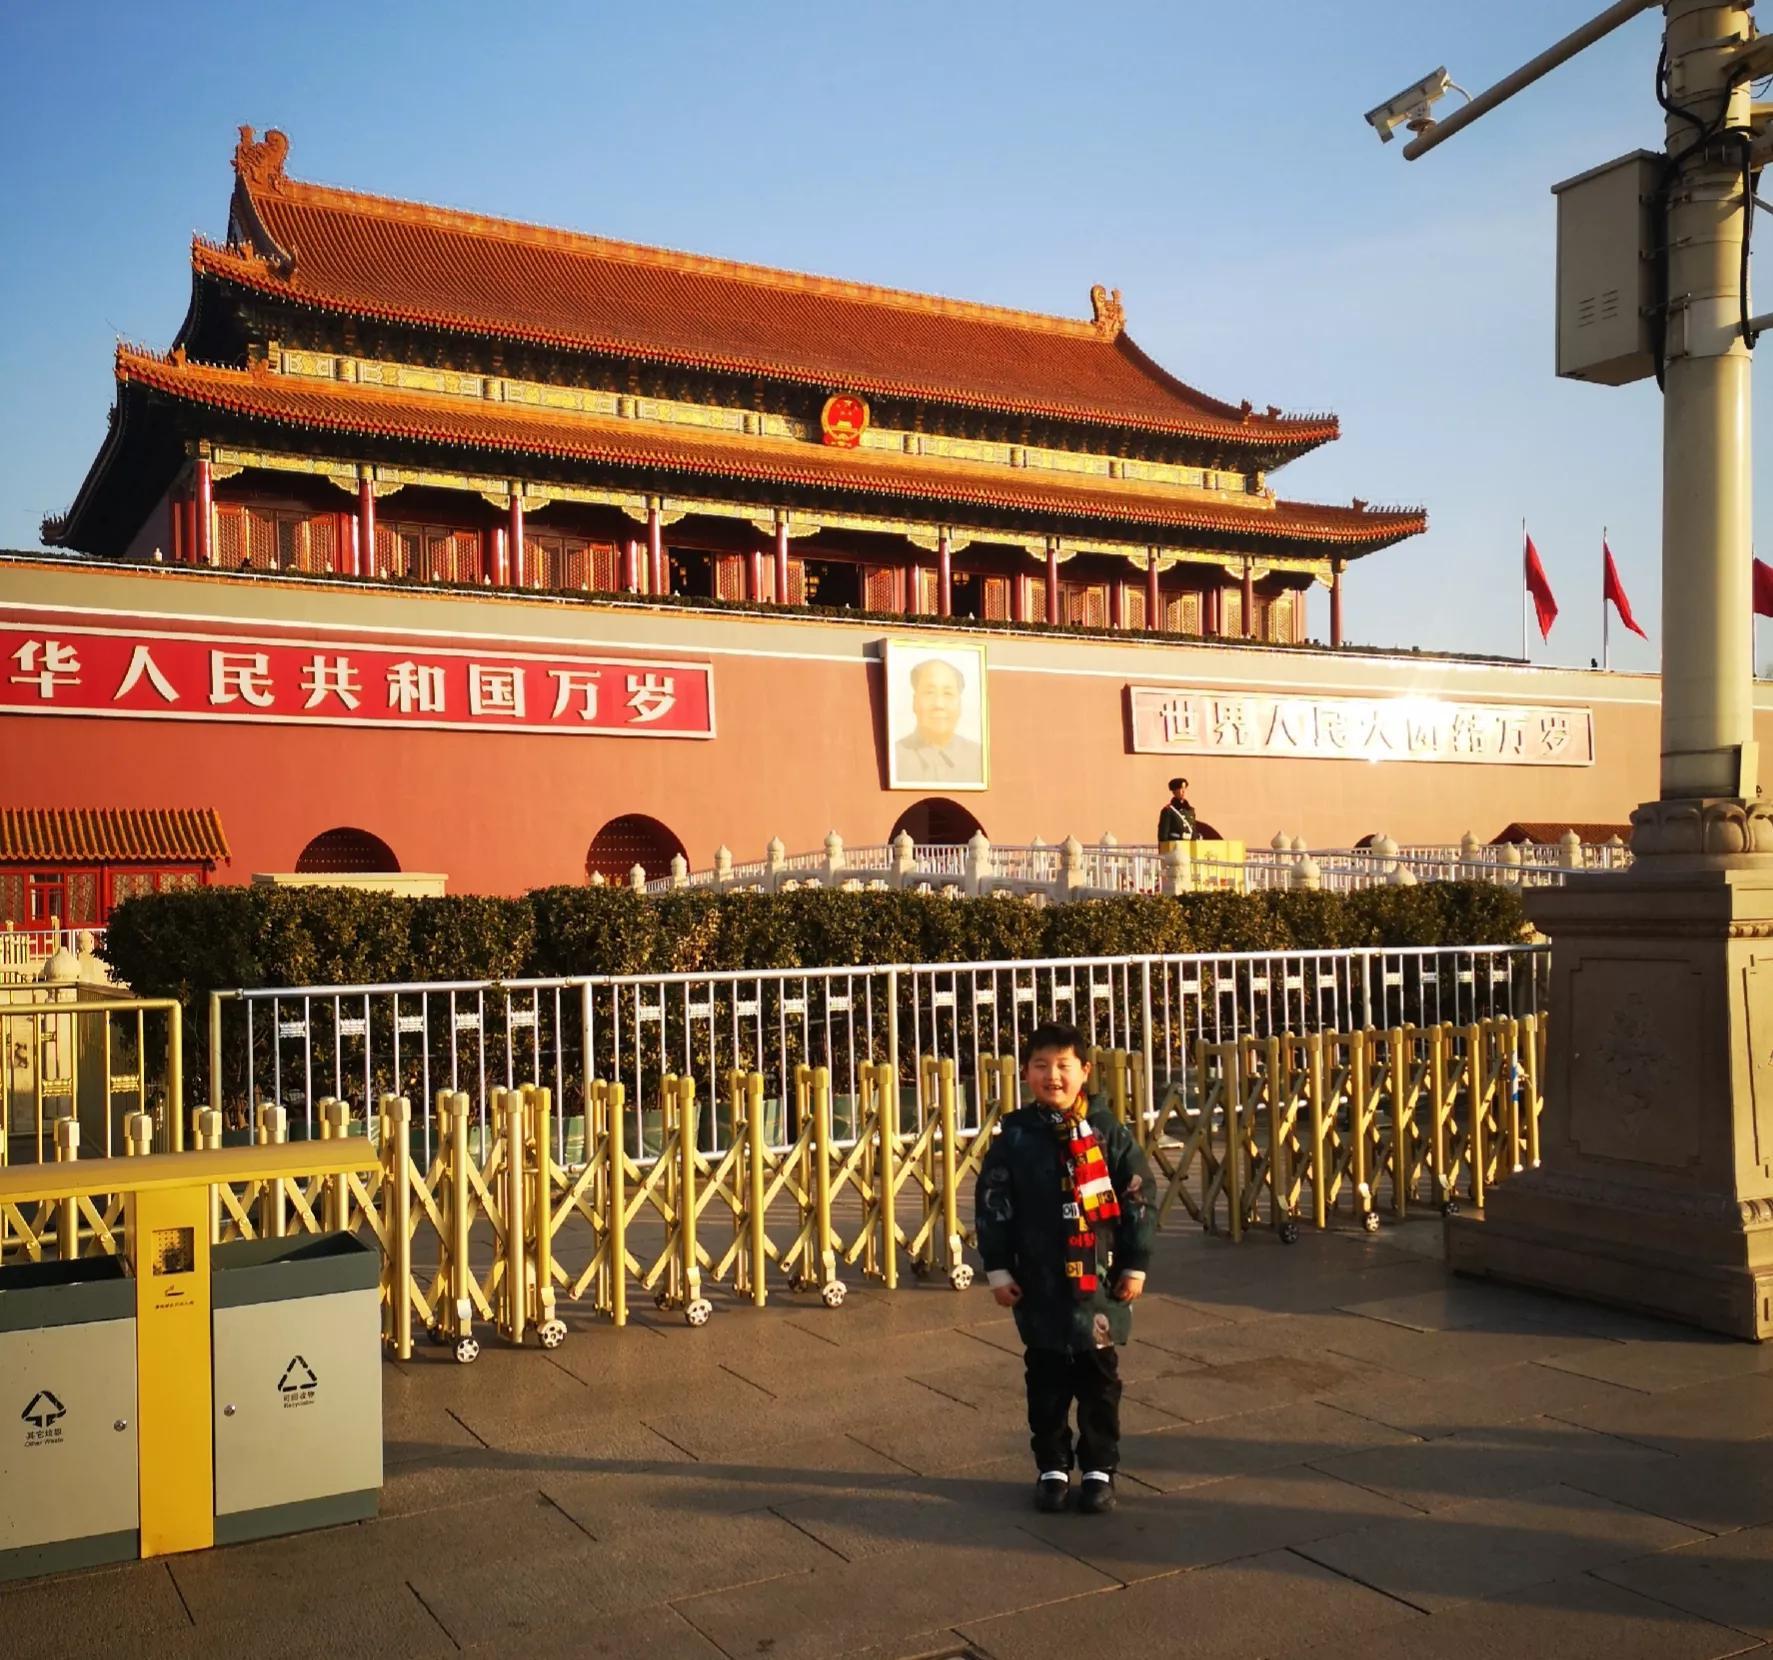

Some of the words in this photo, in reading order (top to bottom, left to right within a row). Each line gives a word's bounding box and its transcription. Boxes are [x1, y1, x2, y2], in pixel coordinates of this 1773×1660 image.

[10, 639, 677, 723] 华人民共和国万岁
